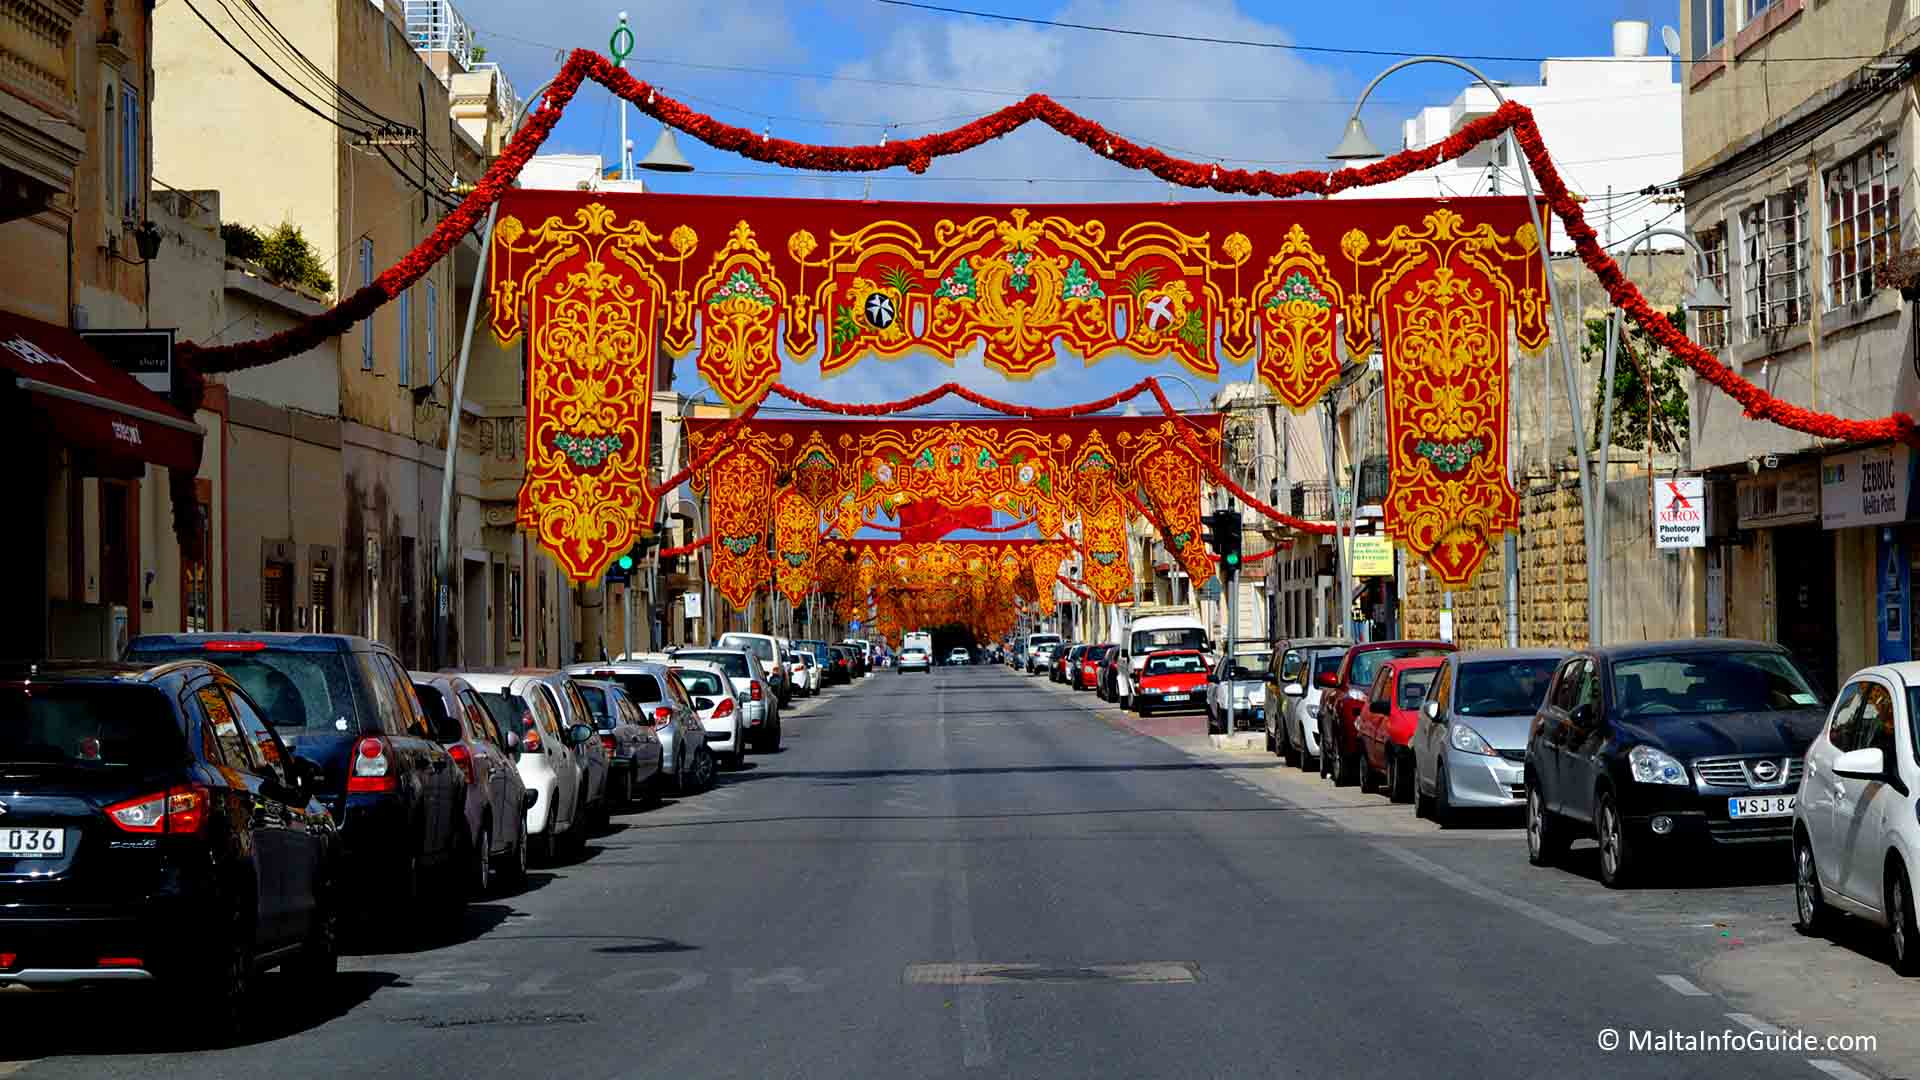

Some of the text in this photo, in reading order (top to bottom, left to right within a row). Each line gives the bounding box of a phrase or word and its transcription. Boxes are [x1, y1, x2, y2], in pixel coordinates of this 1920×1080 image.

[1659, 511, 1700, 521] XEROX
[1660, 525, 1700, 534] Photocopy
[1660, 535, 1689, 543] Service
[1739, 799, 1769, 813] WSJ
[9, 831, 55, 850] 036
